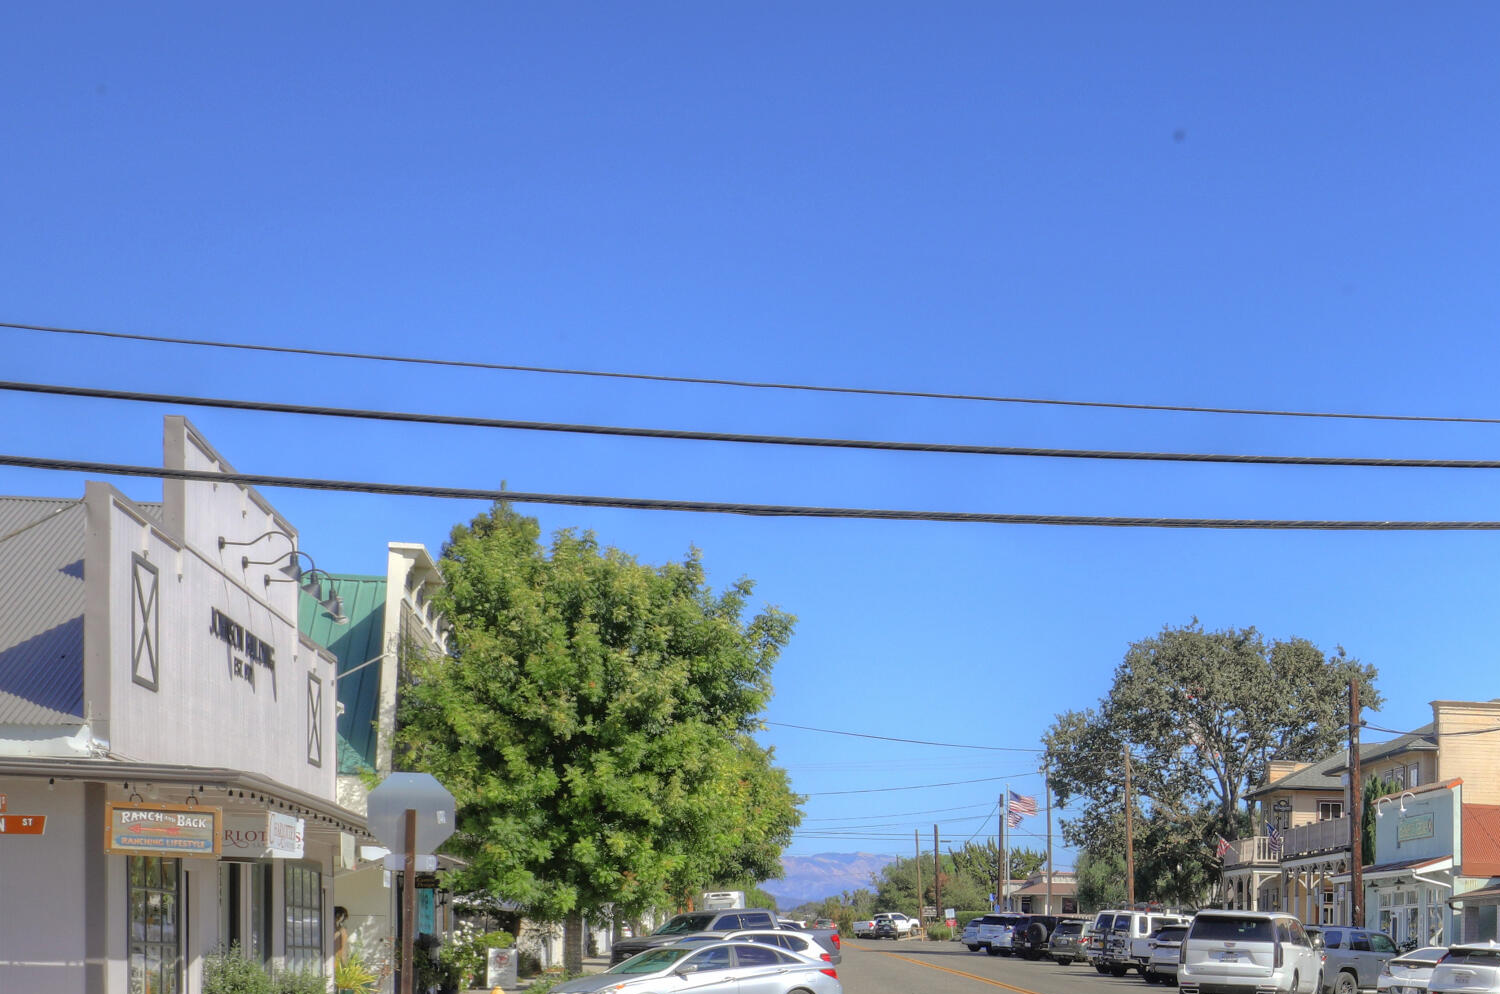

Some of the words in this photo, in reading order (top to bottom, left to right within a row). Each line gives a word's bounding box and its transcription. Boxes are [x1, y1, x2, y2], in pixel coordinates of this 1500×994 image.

[22, 818, 33, 827] ST
[121, 811, 163, 824] RANCH
[177, 814, 206, 828] BACK
[121, 837, 163, 846] RANCHING
[166, 839, 205, 848] LIFESTYLE
